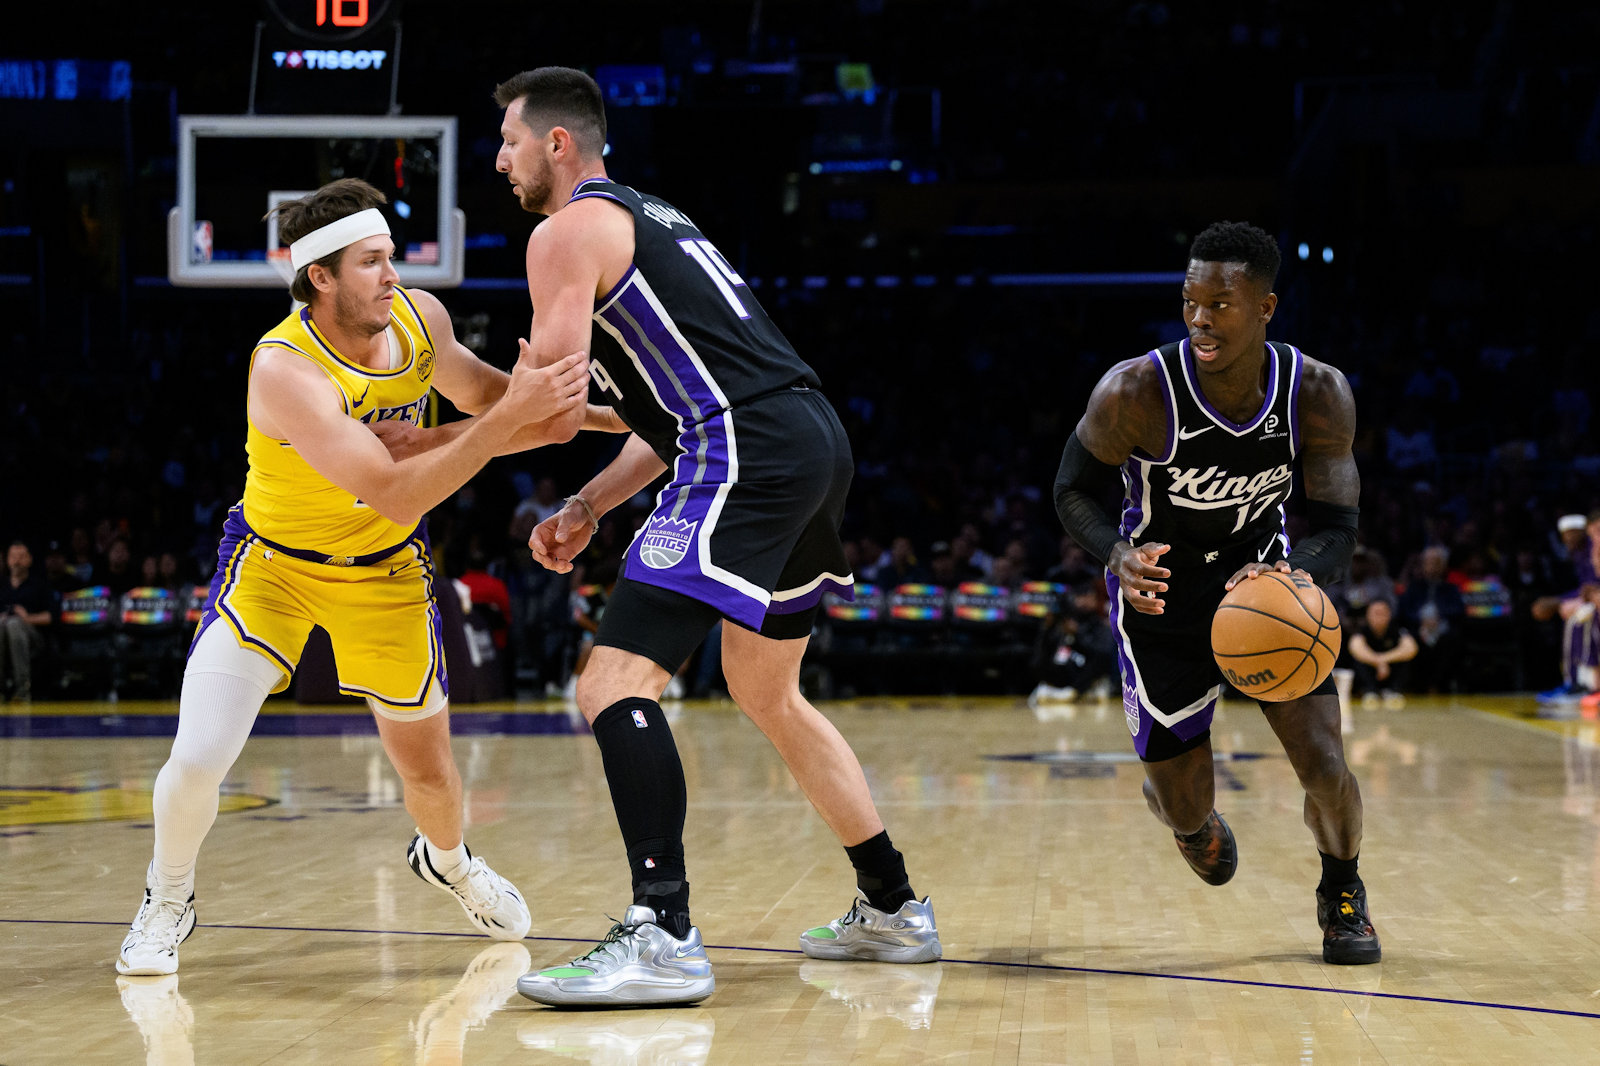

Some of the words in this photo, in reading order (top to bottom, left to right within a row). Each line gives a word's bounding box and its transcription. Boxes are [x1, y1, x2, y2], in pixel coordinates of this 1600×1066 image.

[302, 50, 387, 70] TISSOT
[588, 358, 624, 400] 9
[1167, 464, 1293, 510] Kings
[1231, 491, 1282, 534] 17
[643, 535, 688, 552] KINGS
[1220, 668, 1278, 687] lson
